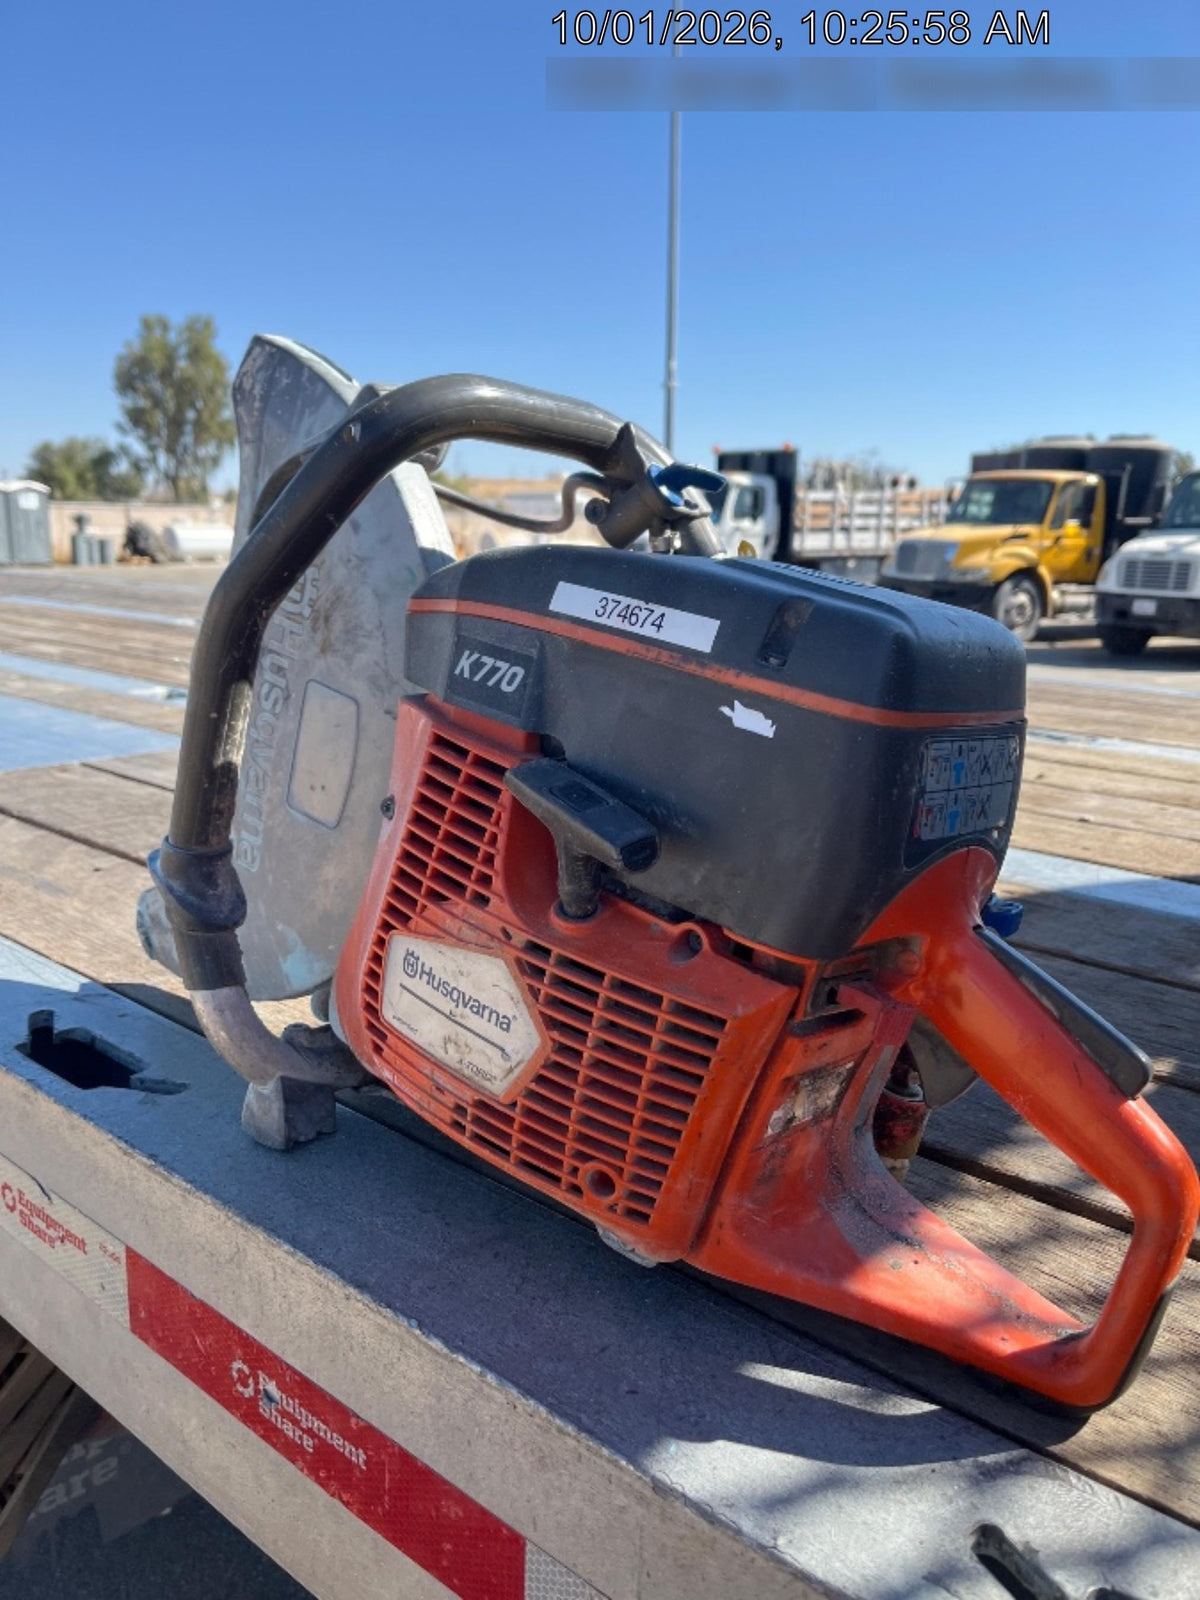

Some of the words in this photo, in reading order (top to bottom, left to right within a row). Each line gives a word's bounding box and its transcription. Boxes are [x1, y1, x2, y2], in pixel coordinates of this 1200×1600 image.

[595, 597, 665, 633] 374674
[454, 650, 525, 693] K770
[19, 1209, 56, 1249] Share
